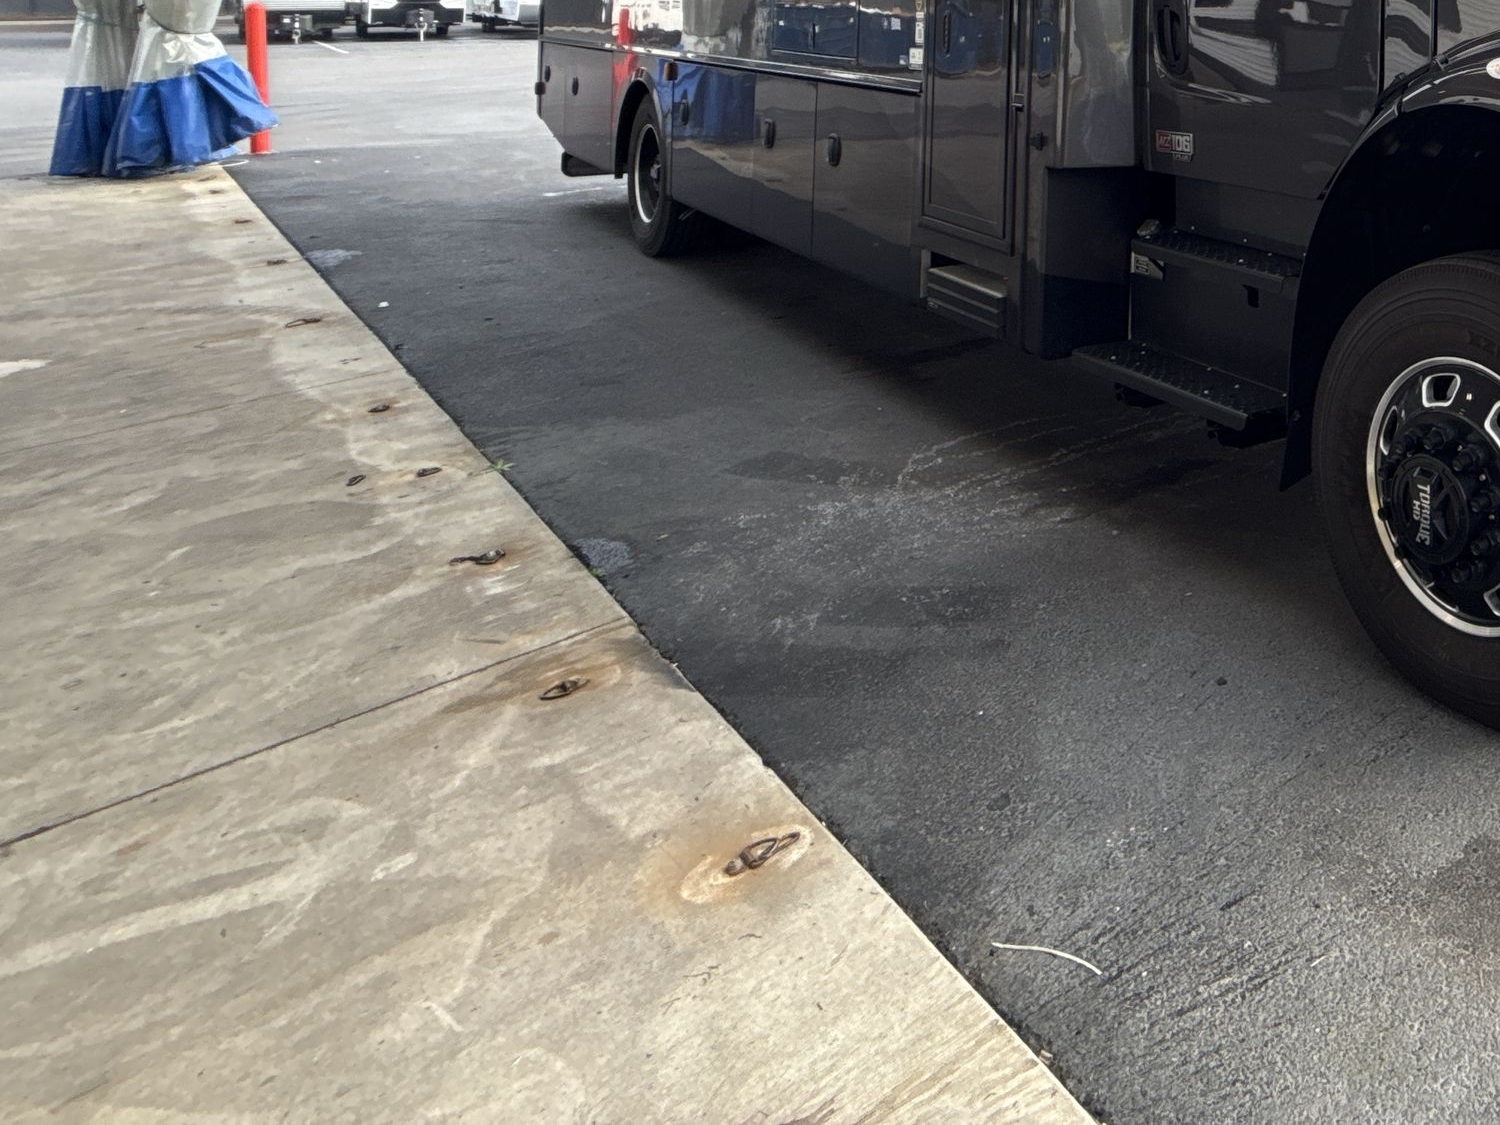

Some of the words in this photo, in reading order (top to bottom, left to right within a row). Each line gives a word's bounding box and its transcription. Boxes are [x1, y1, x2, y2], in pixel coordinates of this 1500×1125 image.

[1172, 135, 1191, 152] 106
[1412, 500, 1421, 521] HD
[1415, 484, 1431, 546] TORQUE
